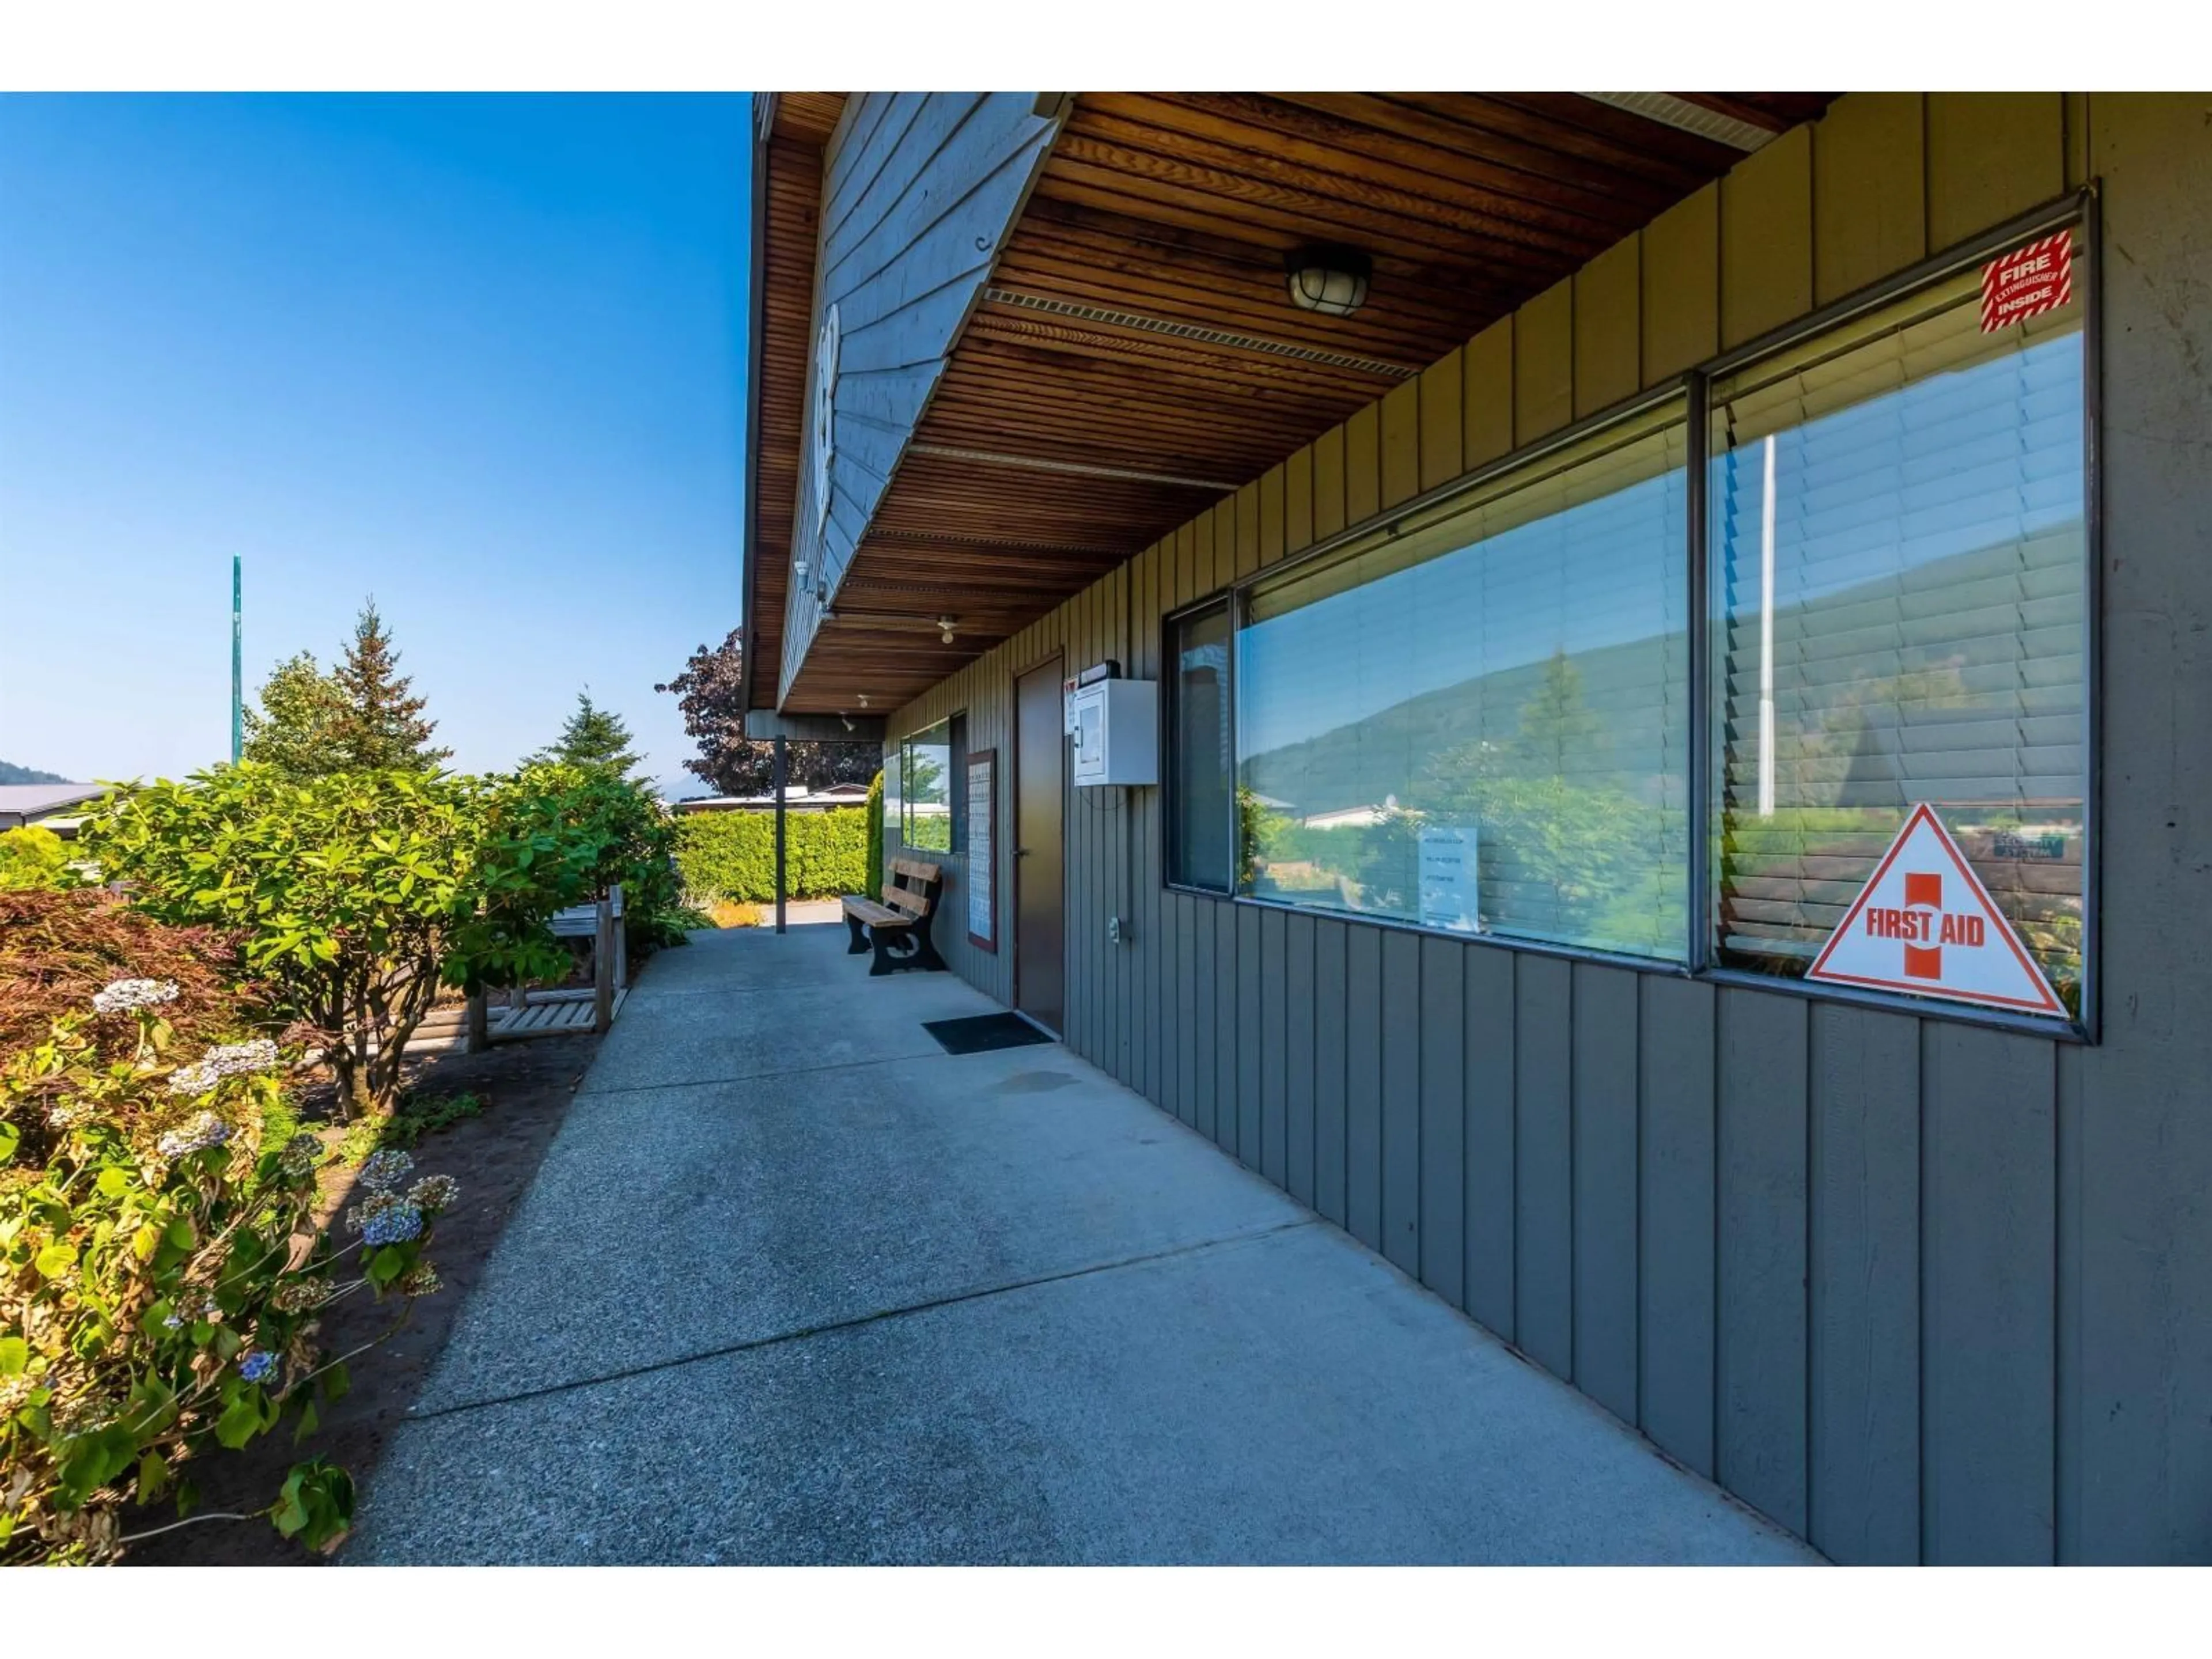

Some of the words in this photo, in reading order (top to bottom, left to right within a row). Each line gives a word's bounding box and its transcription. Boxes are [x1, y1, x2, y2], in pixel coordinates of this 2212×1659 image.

[2000, 252, 2051, 286] FIRE
[1995, 271, 2058, 302] EXTINGUISHER
[1998, 285, 2052, 316] INSIDE
[1866, 907, 1933, 942] FIRST
[1940, 913, 1985, 947] AID
